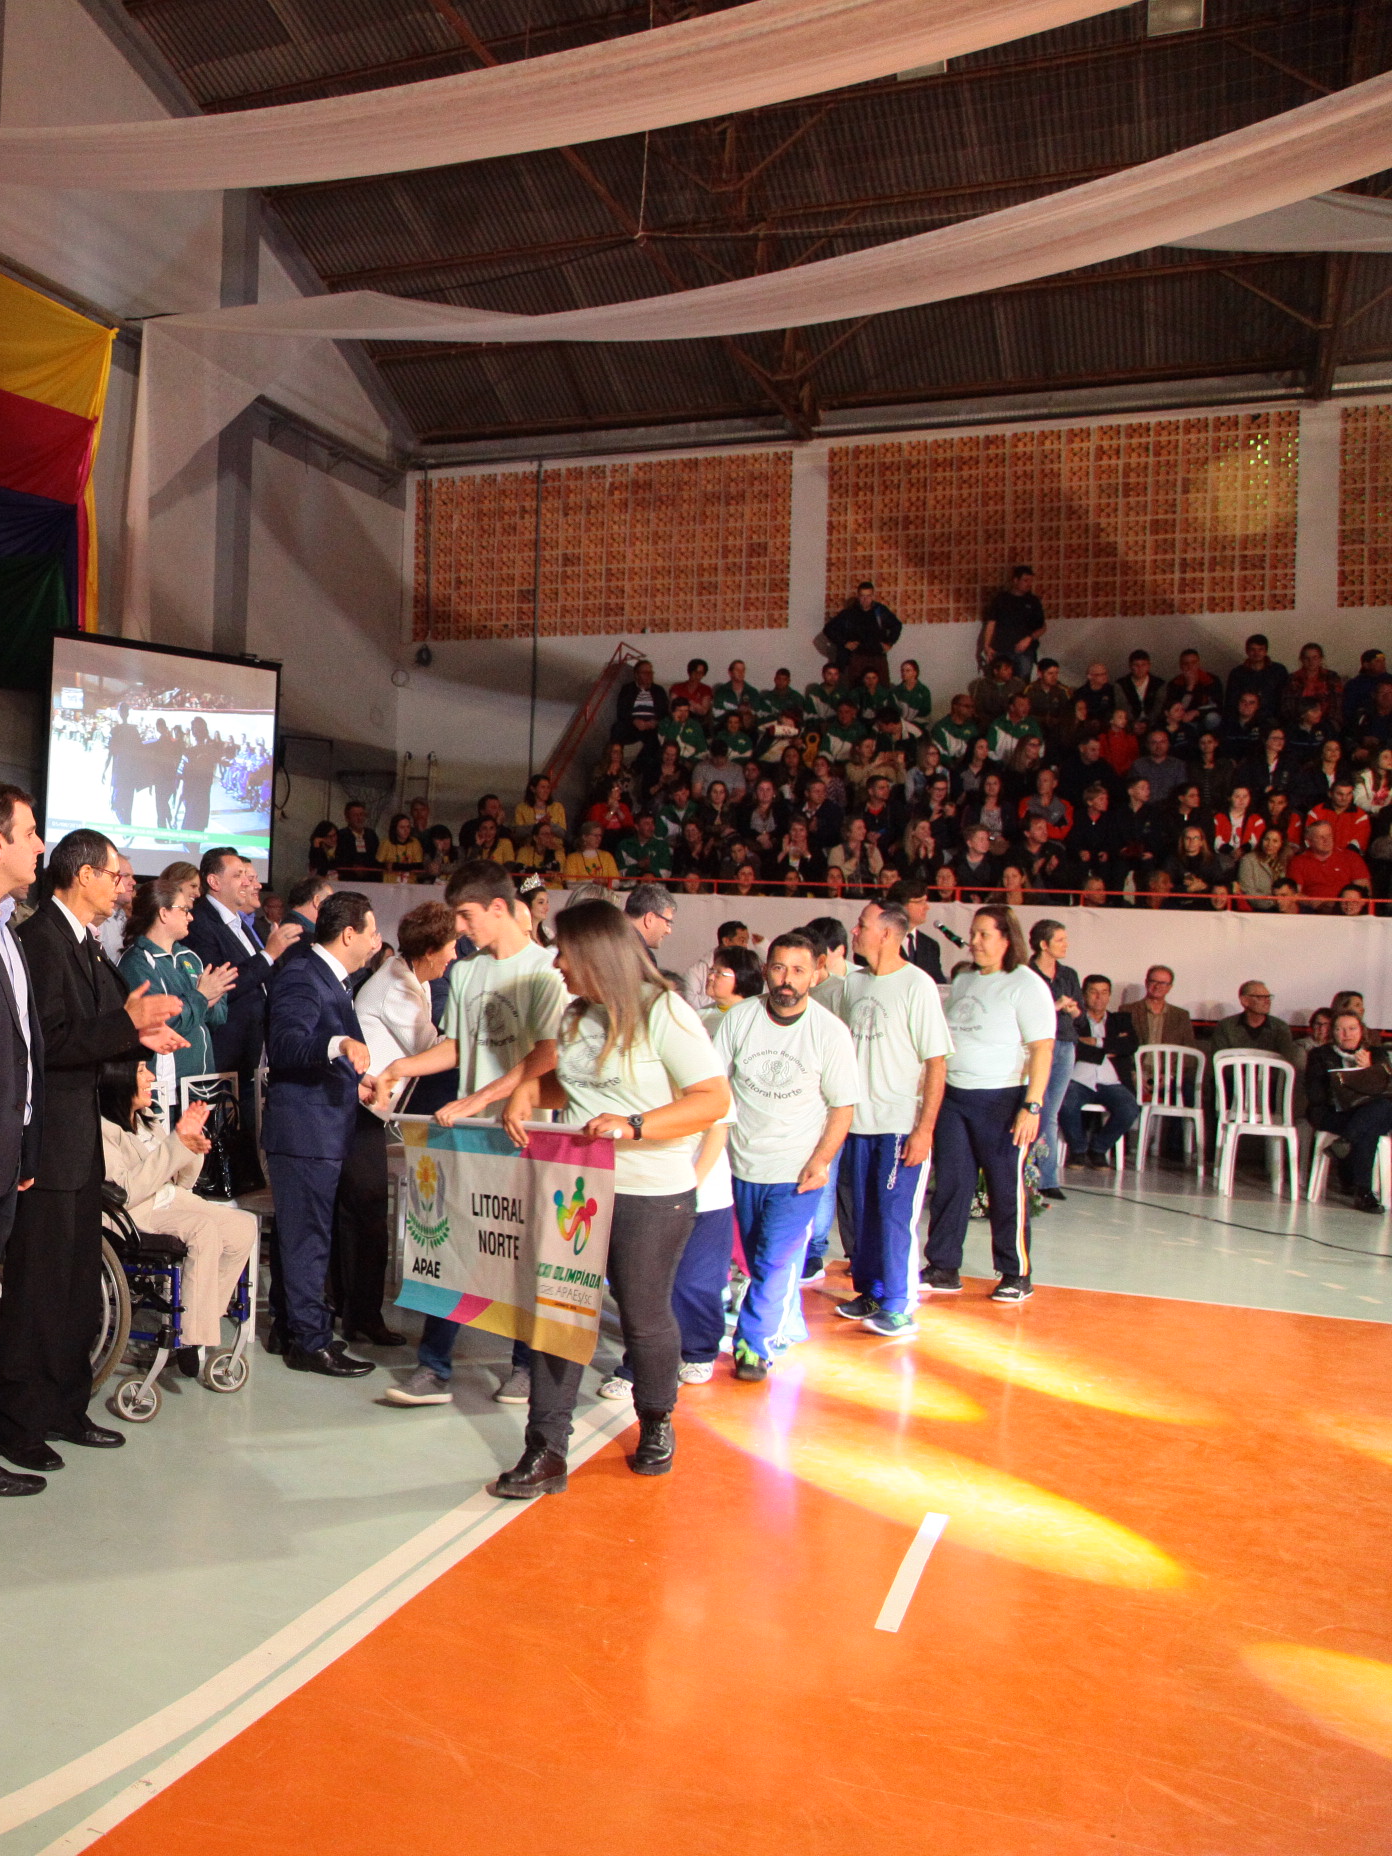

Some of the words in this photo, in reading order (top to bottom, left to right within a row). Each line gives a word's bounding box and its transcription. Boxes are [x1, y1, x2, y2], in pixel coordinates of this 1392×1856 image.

[742, 1049, 779, 1065] Conselho
[780, 1050, 808, 1074] Regional
[744, 1078, 772, 1099] Litoral
[773, 1088, 803, 1099] Norte
[471, 1192, 525, 1225] LITORAL
[478, 1229, 520, 1261] NORTE
[412, 1256, 441, 1279] APAE
